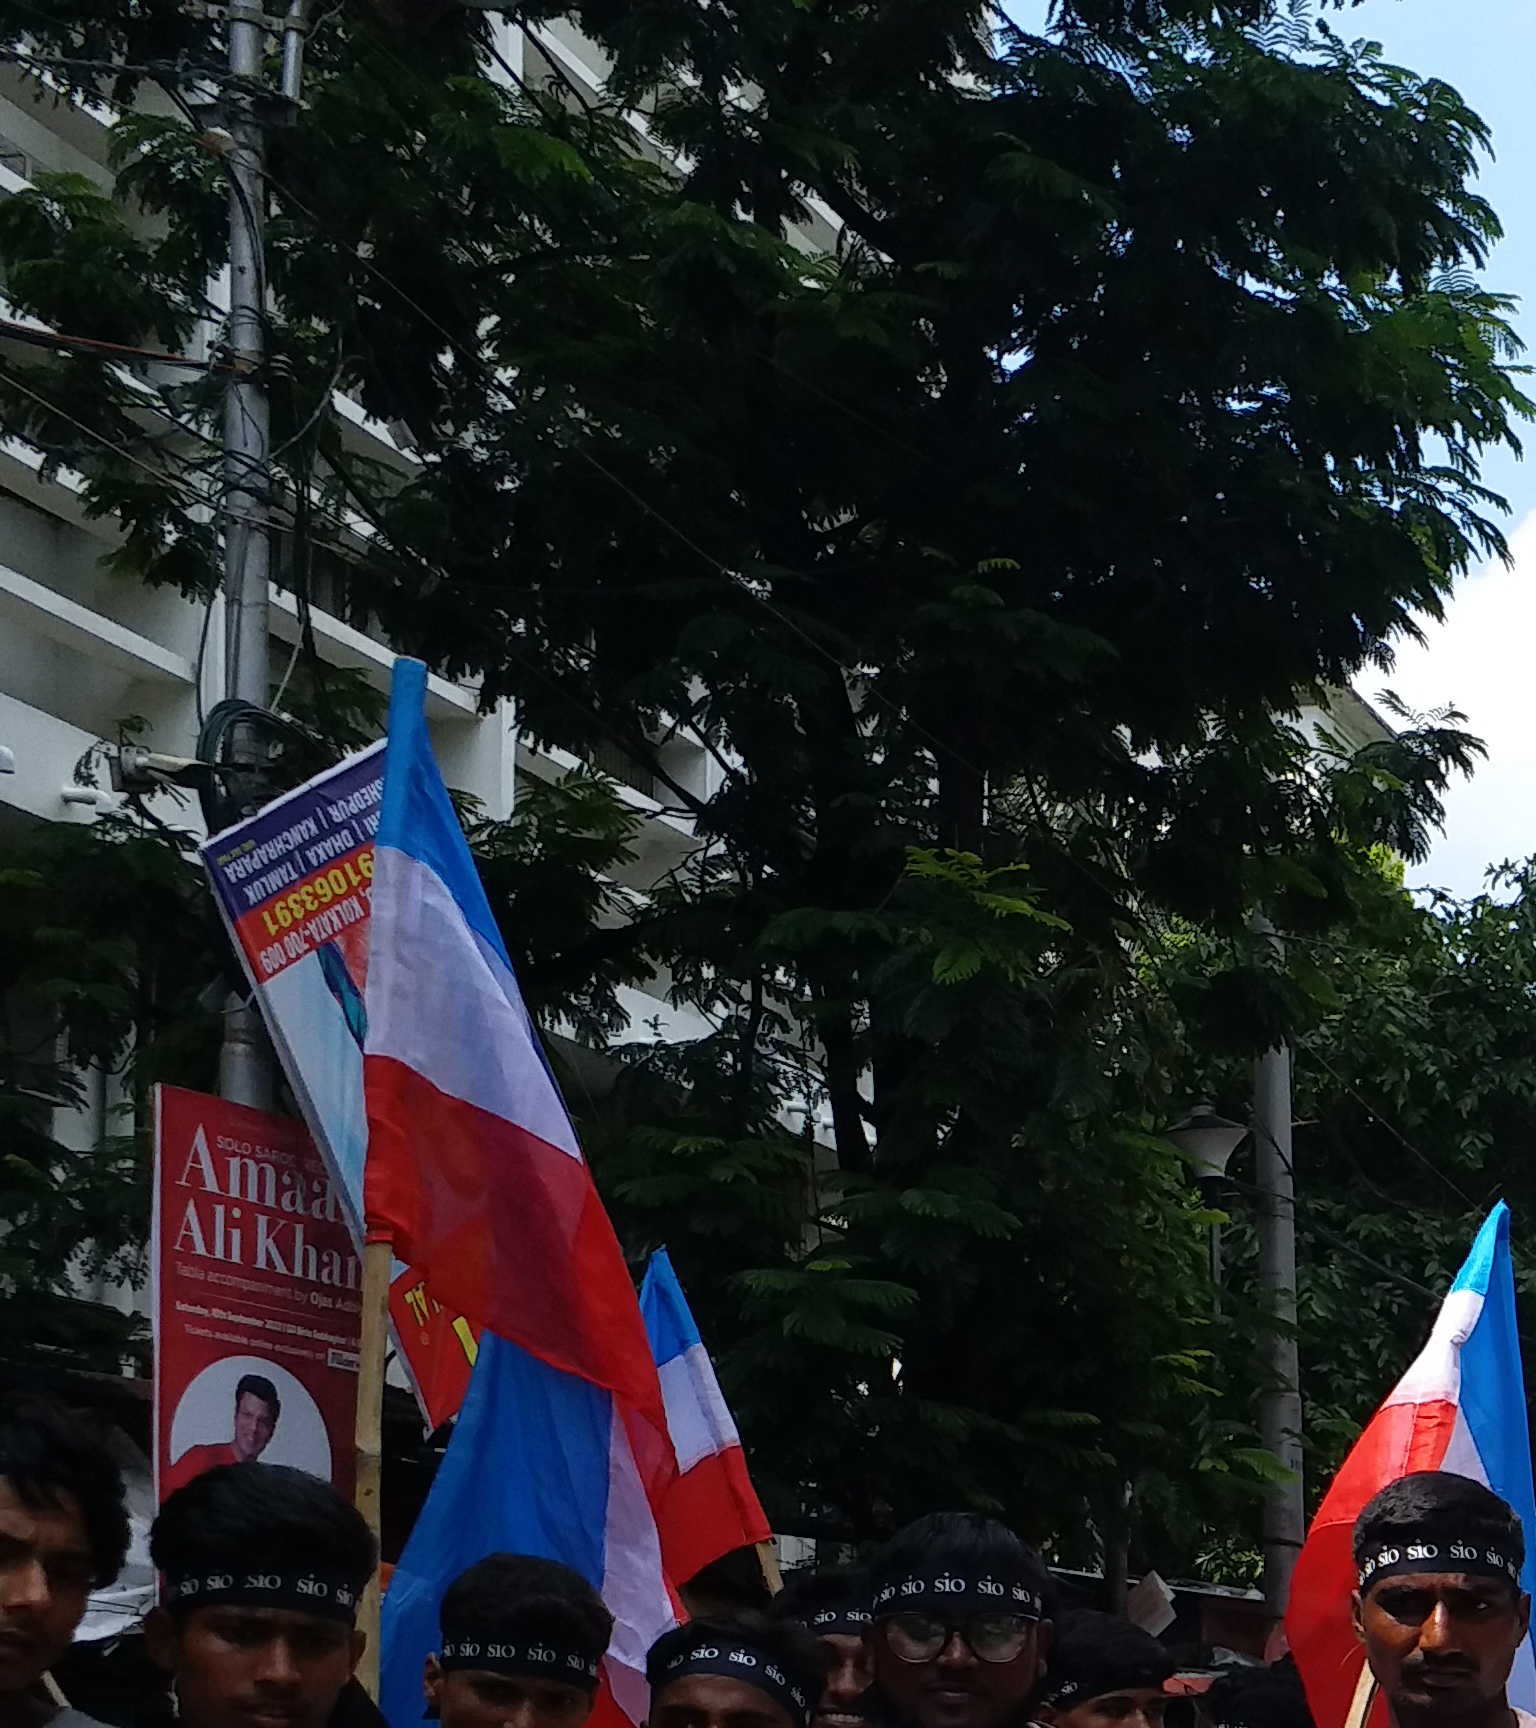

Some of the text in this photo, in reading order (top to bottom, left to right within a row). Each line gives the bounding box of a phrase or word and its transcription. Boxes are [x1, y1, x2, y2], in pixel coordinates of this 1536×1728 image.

[326, 777, 384, 824] SHEDPUR
[223, 816, 320, 884] KANCHRAPARA
[243, 811, 380, 906] RI DHAKA TAMLUK
[262, 850, 375, 937] 91063391
[216, 1135, 251, 1155] SOLO
[174, 1122, 344, 1223] Amaa
[172, 1197, 244, 1265] Ali
[1378, 1545, 1400, 1568] sio
[1406, 1538, 1438, 1560] sio
[1450, 1539, 1478, 1560] sio
[1486, 1546, 1504, 1568] sio
[206, 1571, 234, 1591] sio
[244, 1572, 282, 1590] sio
[296, 1573, 329, 1597] sio
[879, 1571, 1031, 1603] sio sio sio sio sio
[814, 1608, 837, 1626] sio
[459, 1636, 481, 1657] sio
[487, 1643, 515, 1658] sio
[527, 1642, 557, 1663] sio
[566, 1650, 585, 1671] sio
[690, 1643, 719, 1661] sio
[728, 1649, 757, 1667] sio
[765, 1664, 786, 1686] sio
[790, 1686, 806, 1708] sio
